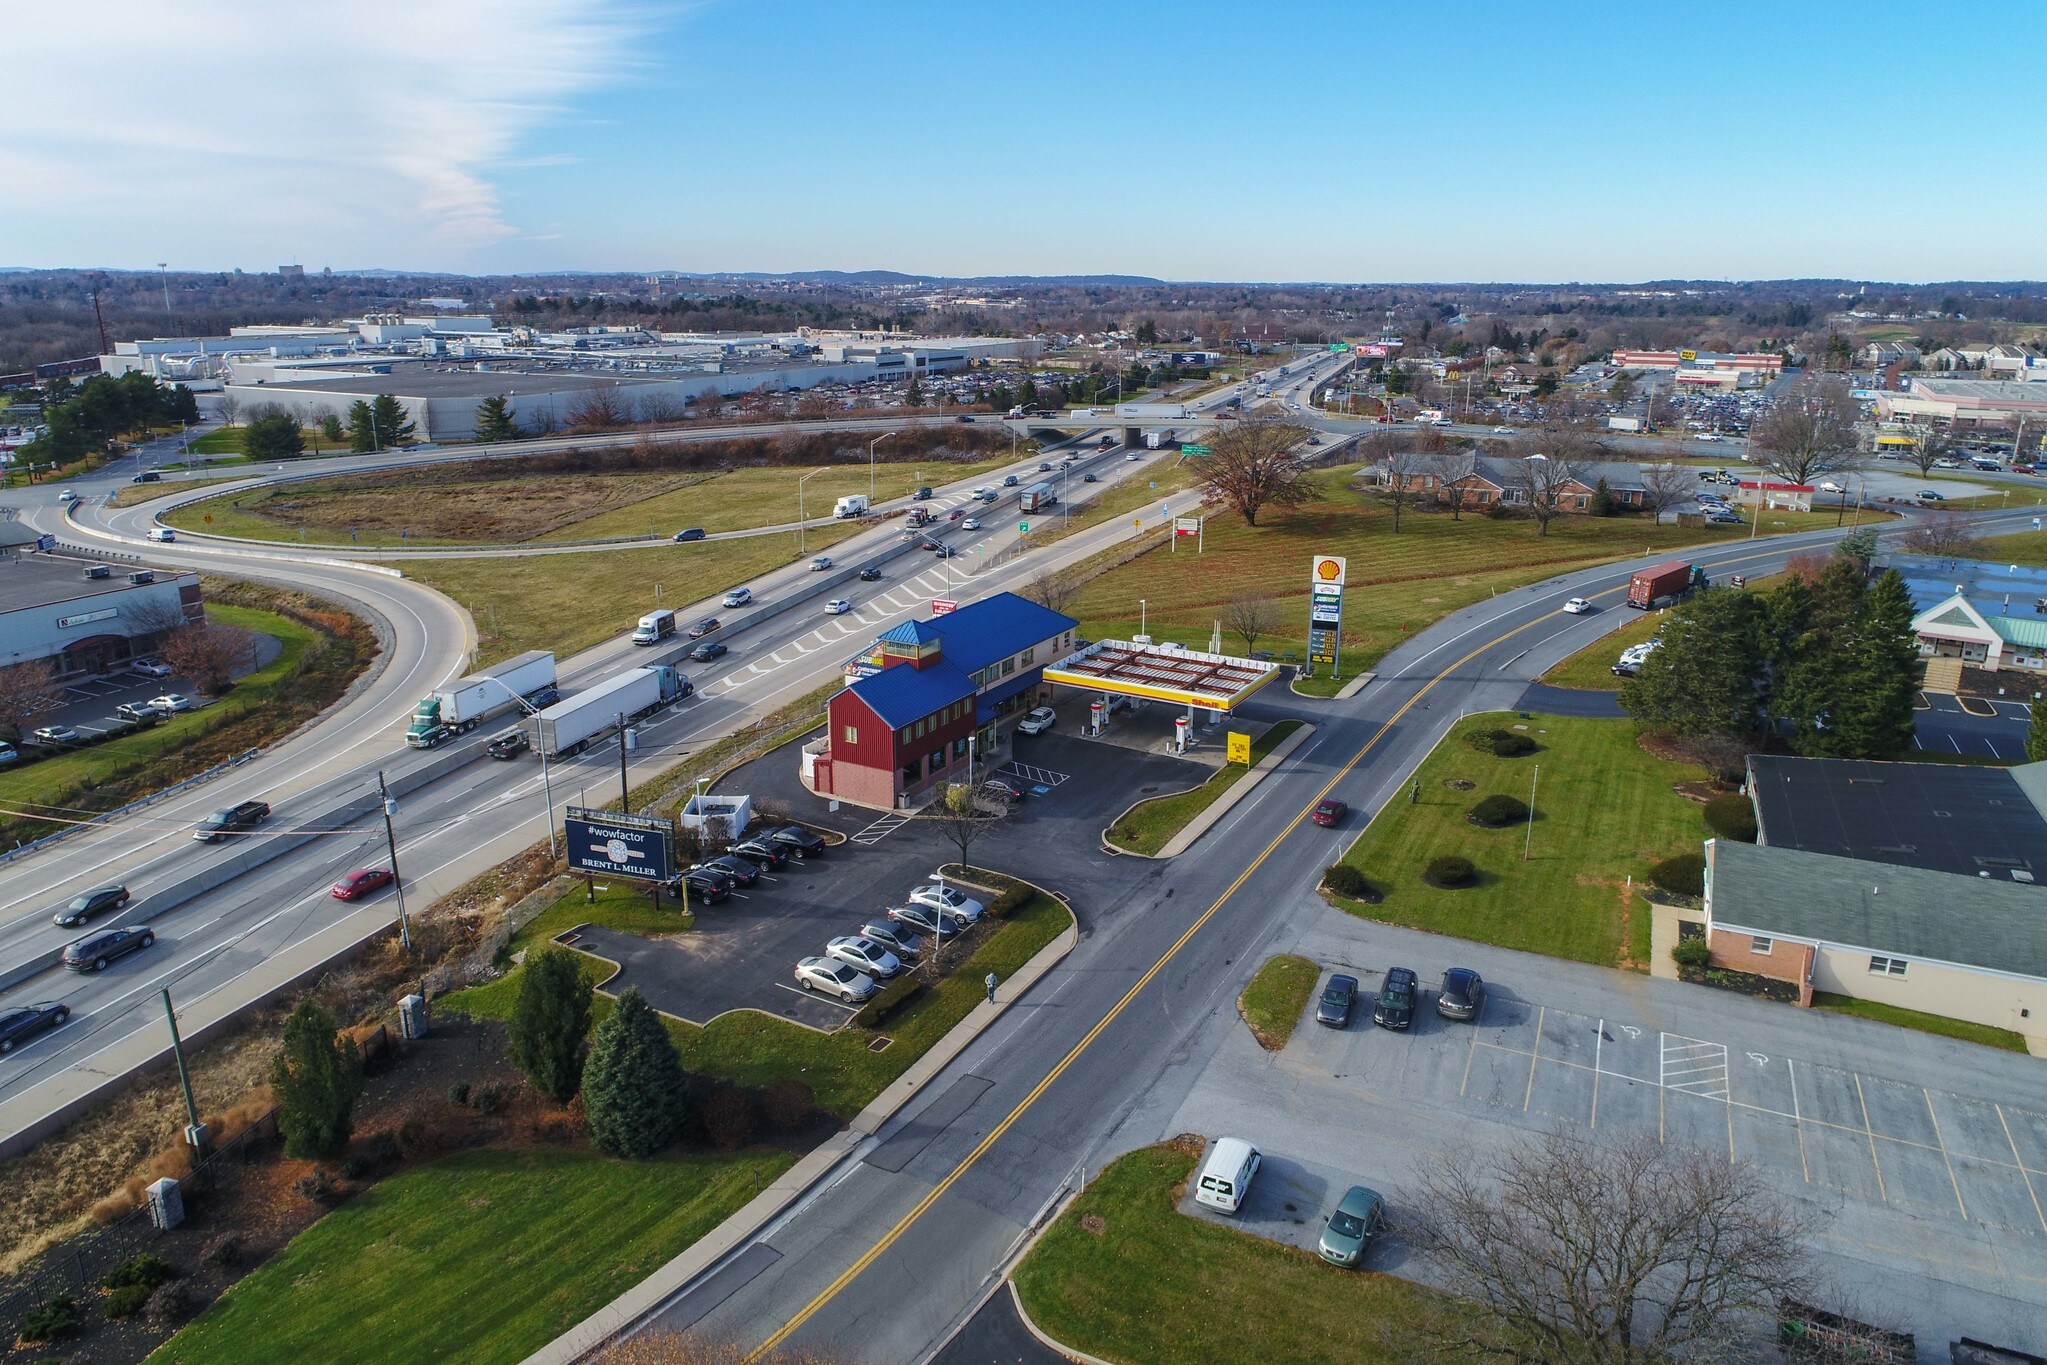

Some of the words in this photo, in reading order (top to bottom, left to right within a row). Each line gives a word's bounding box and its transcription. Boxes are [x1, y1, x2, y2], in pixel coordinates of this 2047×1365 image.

[1315, 595, 1339, 603] SUBWAY
[887, 641, 915, 650] SUBWAY
[859, 656, 883, 666] SUBWA
[1191, 698, 1219, 709] Shell
[587, 825, 645, 842] #wowfactor
[581, 858, 612, 870] BRENT
[613, 863, 621, 871] L.
[622, 865, 657, 877] MILLER
